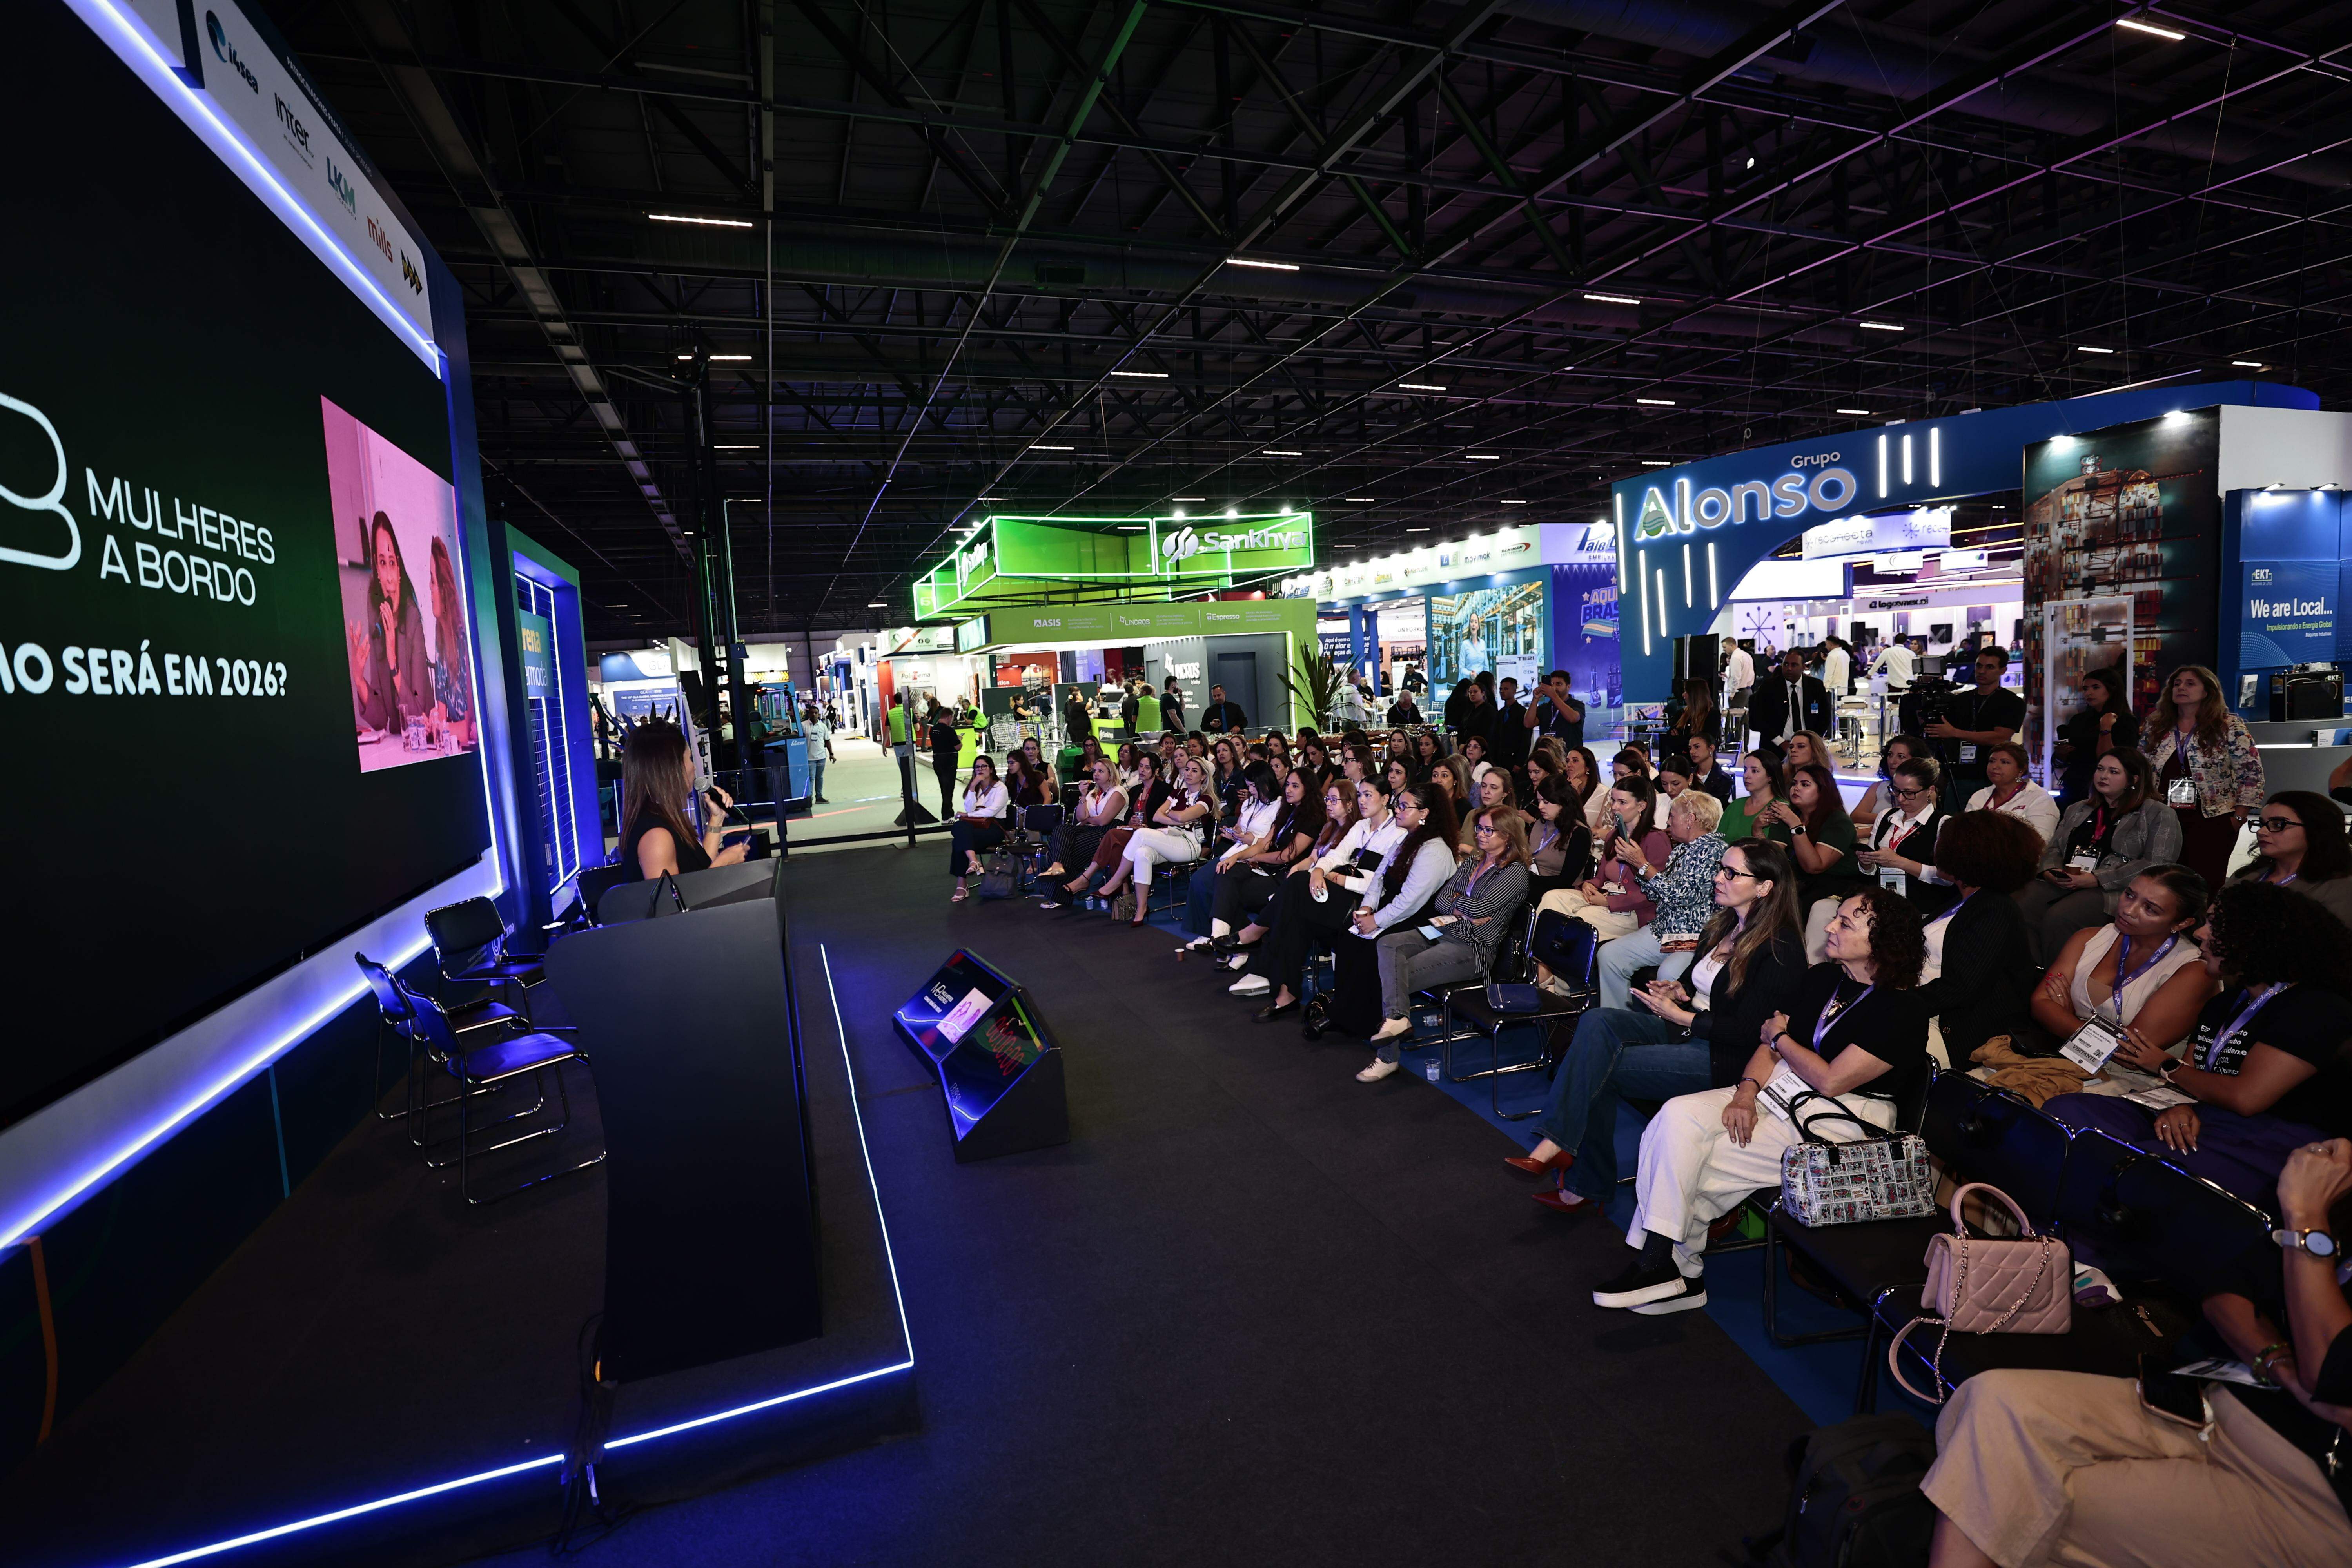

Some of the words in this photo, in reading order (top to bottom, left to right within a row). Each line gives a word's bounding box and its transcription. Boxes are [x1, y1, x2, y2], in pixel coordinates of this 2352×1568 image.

[327, 156, 356, 214] LKM
[367, 216, 393, 263] mills
[1791, 450, 1841, 468] Grupo
[1634, 467, 1857, 541] Alonso
[86, 467, 275, 565] MULHERES
[1204, 527, 1307, 552] Sankhya
[100, 534, 131, 584] A
[136, 541, 256, 606] BORDO
[2255, 569, 2270, 579] EKT
[1212, 613, 1240, 621] Espresso
[2250, 599, 2270, 619] We
[2272, 602, 2291, 618] are
[2294, 597, 2333, 616] Local...
[1042, 619, 1061, 627] ASIS
[1125, 618, 1150, 626] LINCROS
[2266, 621, 2298, 632] Impulsionando
[2302, 621, 2319, 630] Energia
[62, 639, 161, 695] SERÁ
[164, 649, 213, 694] EM
[218, 658, 287, 697] 2026?
[2250, 992, 2270, 1010] logcomex
[2213, 1034, 2231, 1053] logcomex
[2072, 1044, 2097, 1063] VISITANTE
[1766, 1087, 1785, 1104] CONVIDADO
